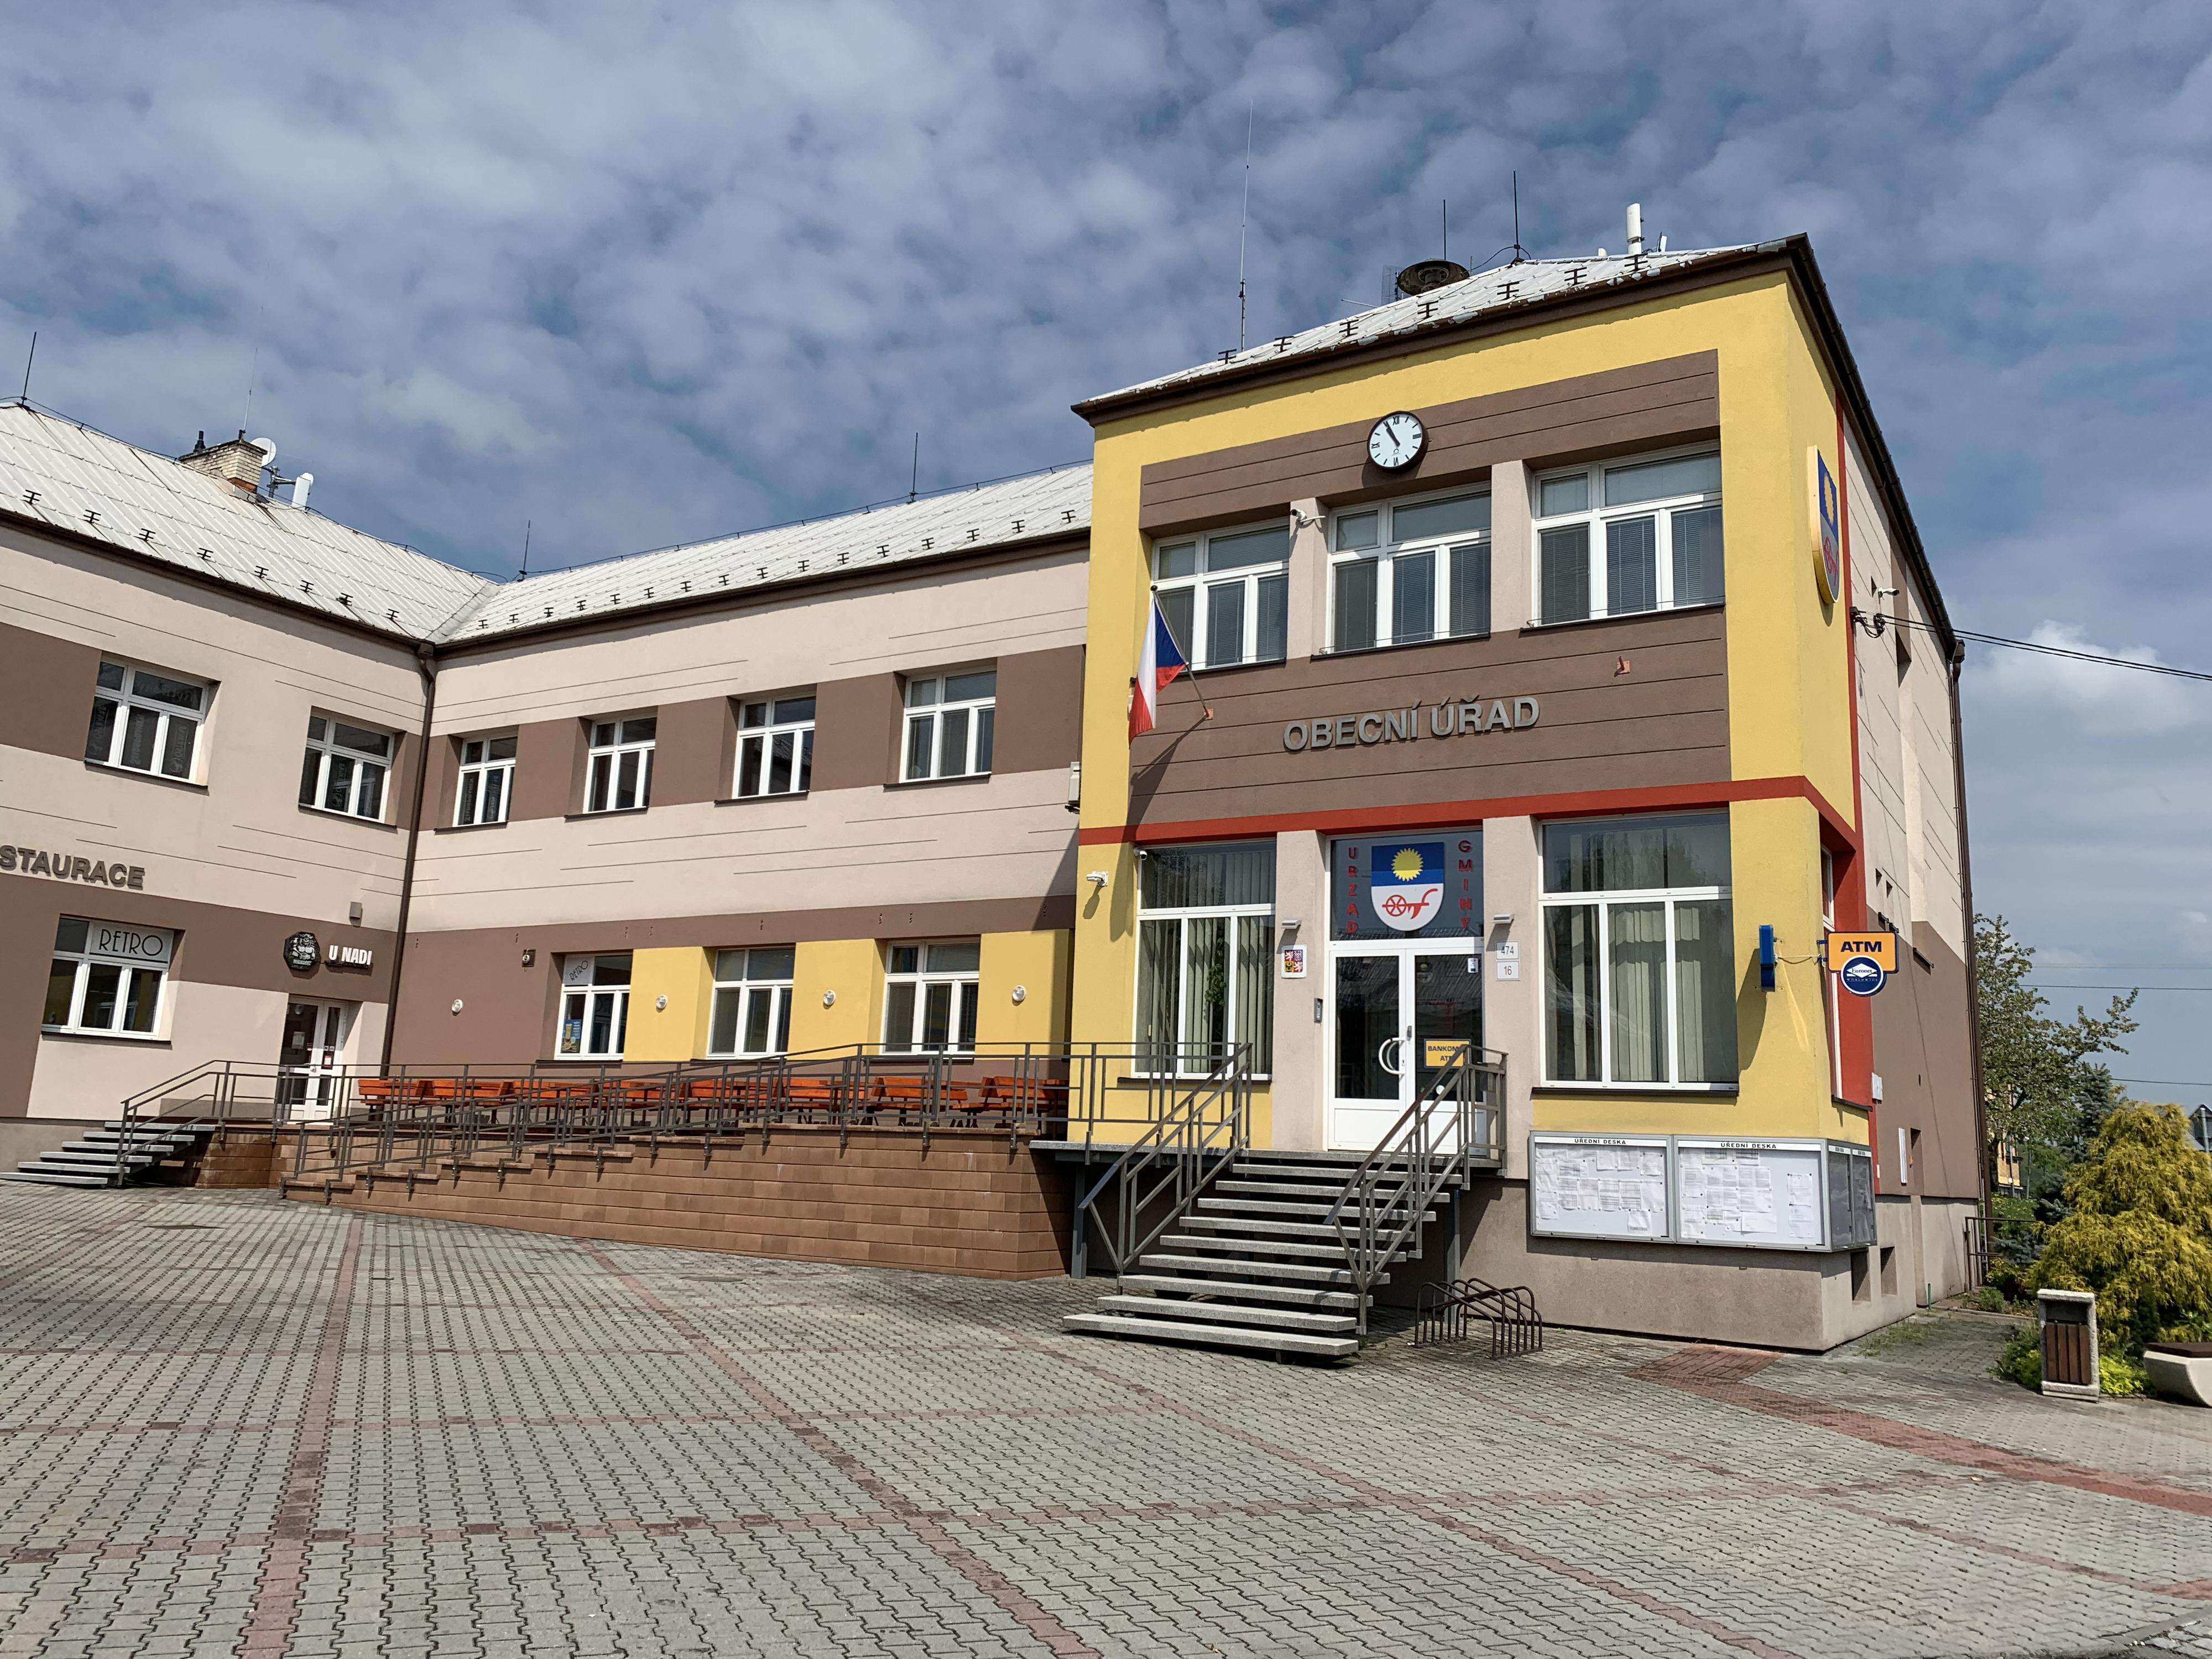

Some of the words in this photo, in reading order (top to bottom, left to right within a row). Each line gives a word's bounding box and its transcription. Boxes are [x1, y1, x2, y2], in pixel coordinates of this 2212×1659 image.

[1283, 700, 1422, 751] OBECNÍ
[1431, 695, 1541, 737] ÚŘAD
[0, 845, 145, 890] STAURACE
[1458, 840, 1473, 930] GMINY
[99, 929, 163, 956] RETRO
[1501, 946, 1514, 955] 474
[1840, 941, 1882, 952] ATM
[328, 945, 338, 961] U
[341, 947, 373, 966] NADI
[570, 960, 588, 982] RETRO
[1504, 966, 1512, 975] 16
